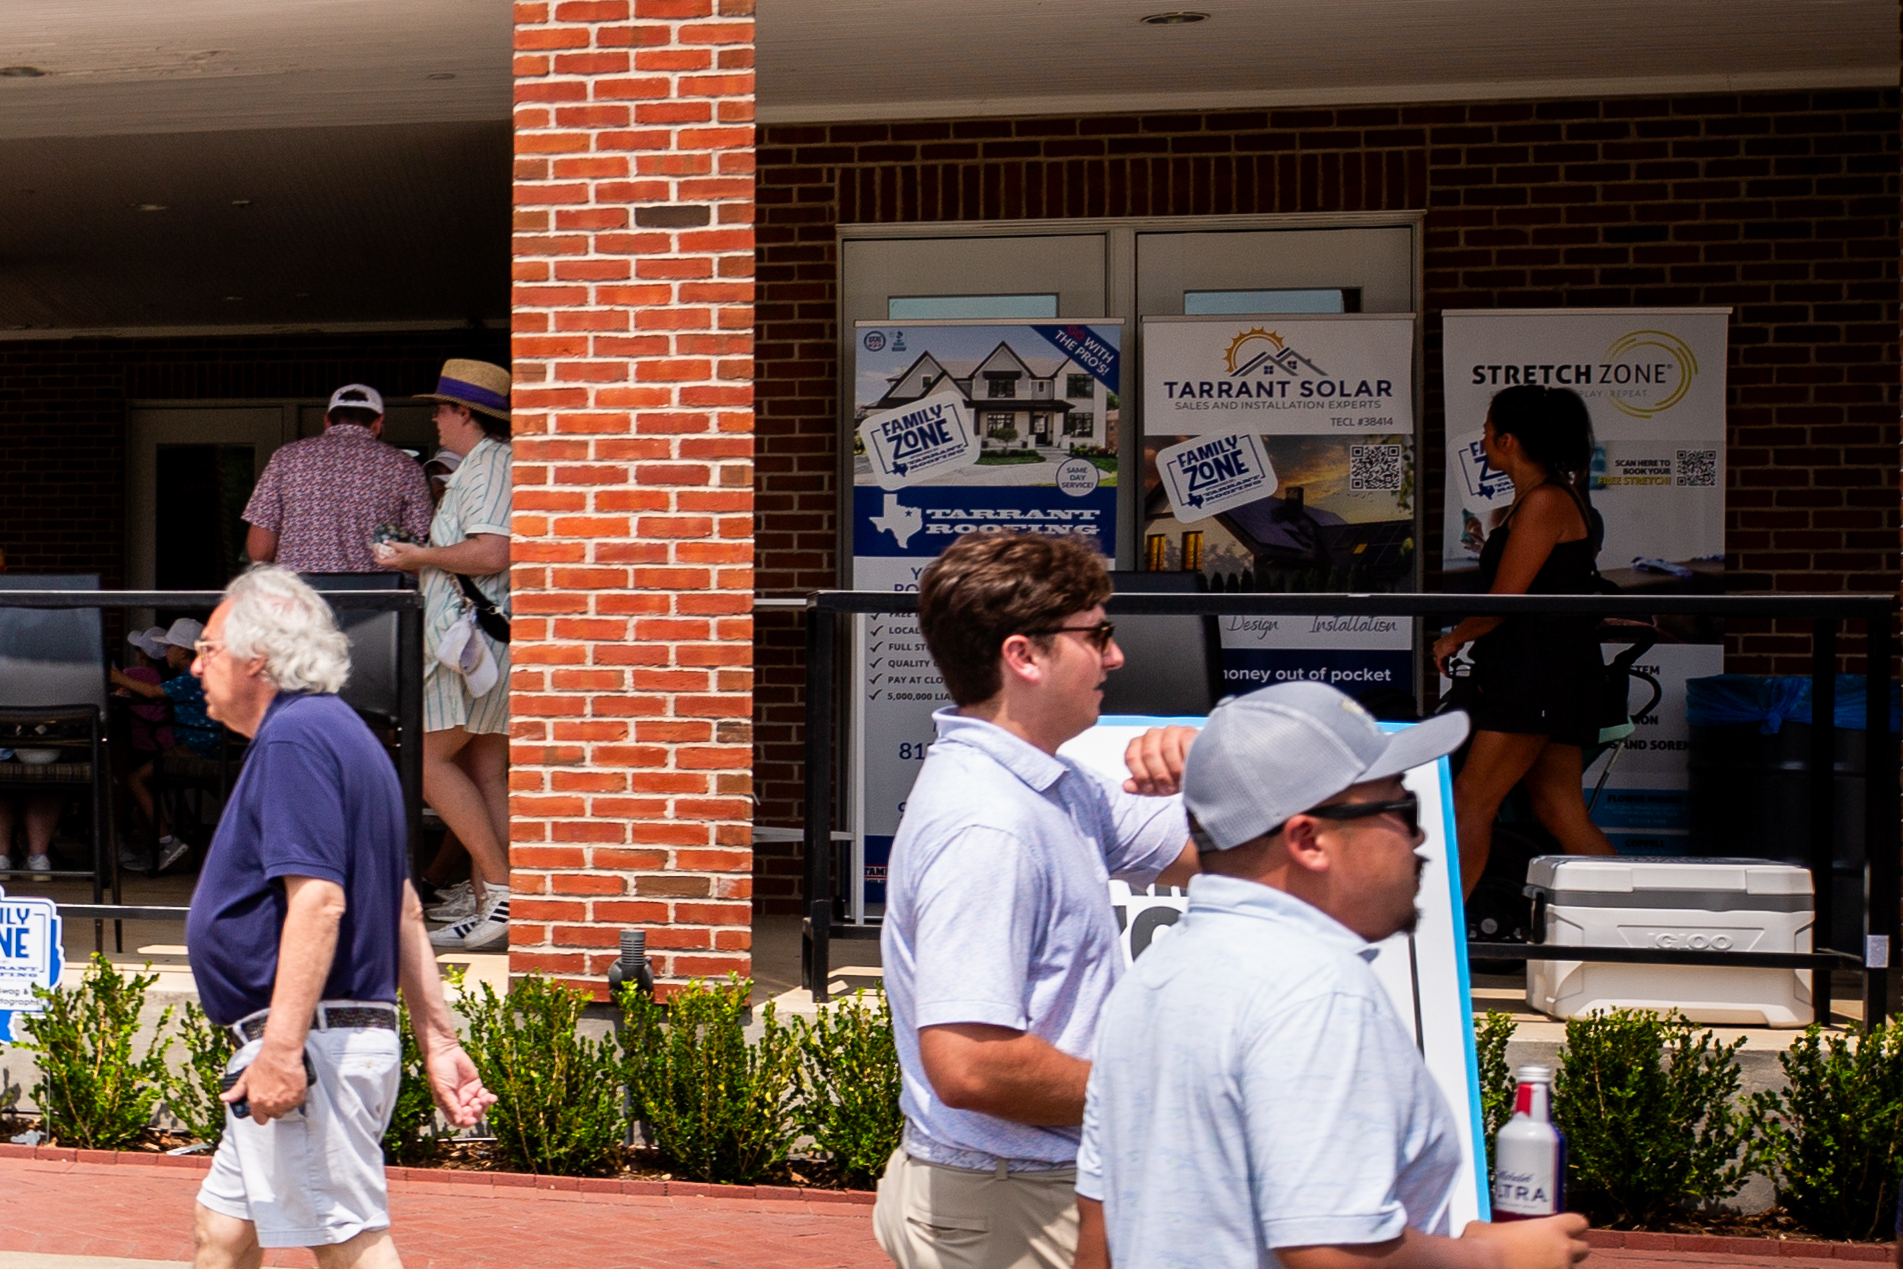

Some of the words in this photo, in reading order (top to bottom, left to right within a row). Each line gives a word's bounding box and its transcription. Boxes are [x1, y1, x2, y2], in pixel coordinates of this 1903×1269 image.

[1055, 330, 1078, 351] THE
[1075, 346, 1110, 376] PRO'S!
[1085, 337, 1114, 363] WITH
[1472, 364, 1591, 384] STRETCH
[1163, 380, 1291, 398] TARRANT
[1300, 380, 1393, 398] SOLAR
[1175, 401, 1210, 410] SALES
[1212, 401, 1238, 410] AND
[1241, 400, 1325, 410] INSTALLATION
[1328, 400, 1382, 409] EXPERTS
[881, 404, 943, 436] FAMILY
[1330, 417, 1355, 427] TECL
[1357, 417, 1394, 426] #38414
[886, 418, 954, 460] ZONE
[1176, 435, 1238, 467] FAMILY
[1615, 459, 1636, 467] SCAN
[1638, 459, 1659, 467] HERE
[1661, 459, 1671, 467] TO
[1066, 466, 1088, 475] SAME
[1182, 449, 1250, 491] ZONE
[1068, 473, 1086, 482] DAY
[1061, 481, 1095, 489] SERVICE!
[925, 509, 1101, 520] TARRANT
[925, 523, 1099, 535] ROOFING
[1226, 615, 1280, 640] Design
[1309, 615, 1398, 633] Installation
[888, 643, 911, 651] FULL
[888, 659, 931, 668] QUALITY
[887, 676, 907, 684] PAY
[908, 676, 922, 684] AT
[924, 676, 945, 684] CLO
[1275, 668, 1304, 681] out
[1309, 667, 1328, 681] of
[1331, 668, 1392, 683] pocket
[887, 693, 933, 702] 5,000,000
[1650, 740, 1689, 750] SOREN
[1647, 932, 1734, 950] IGLOO
